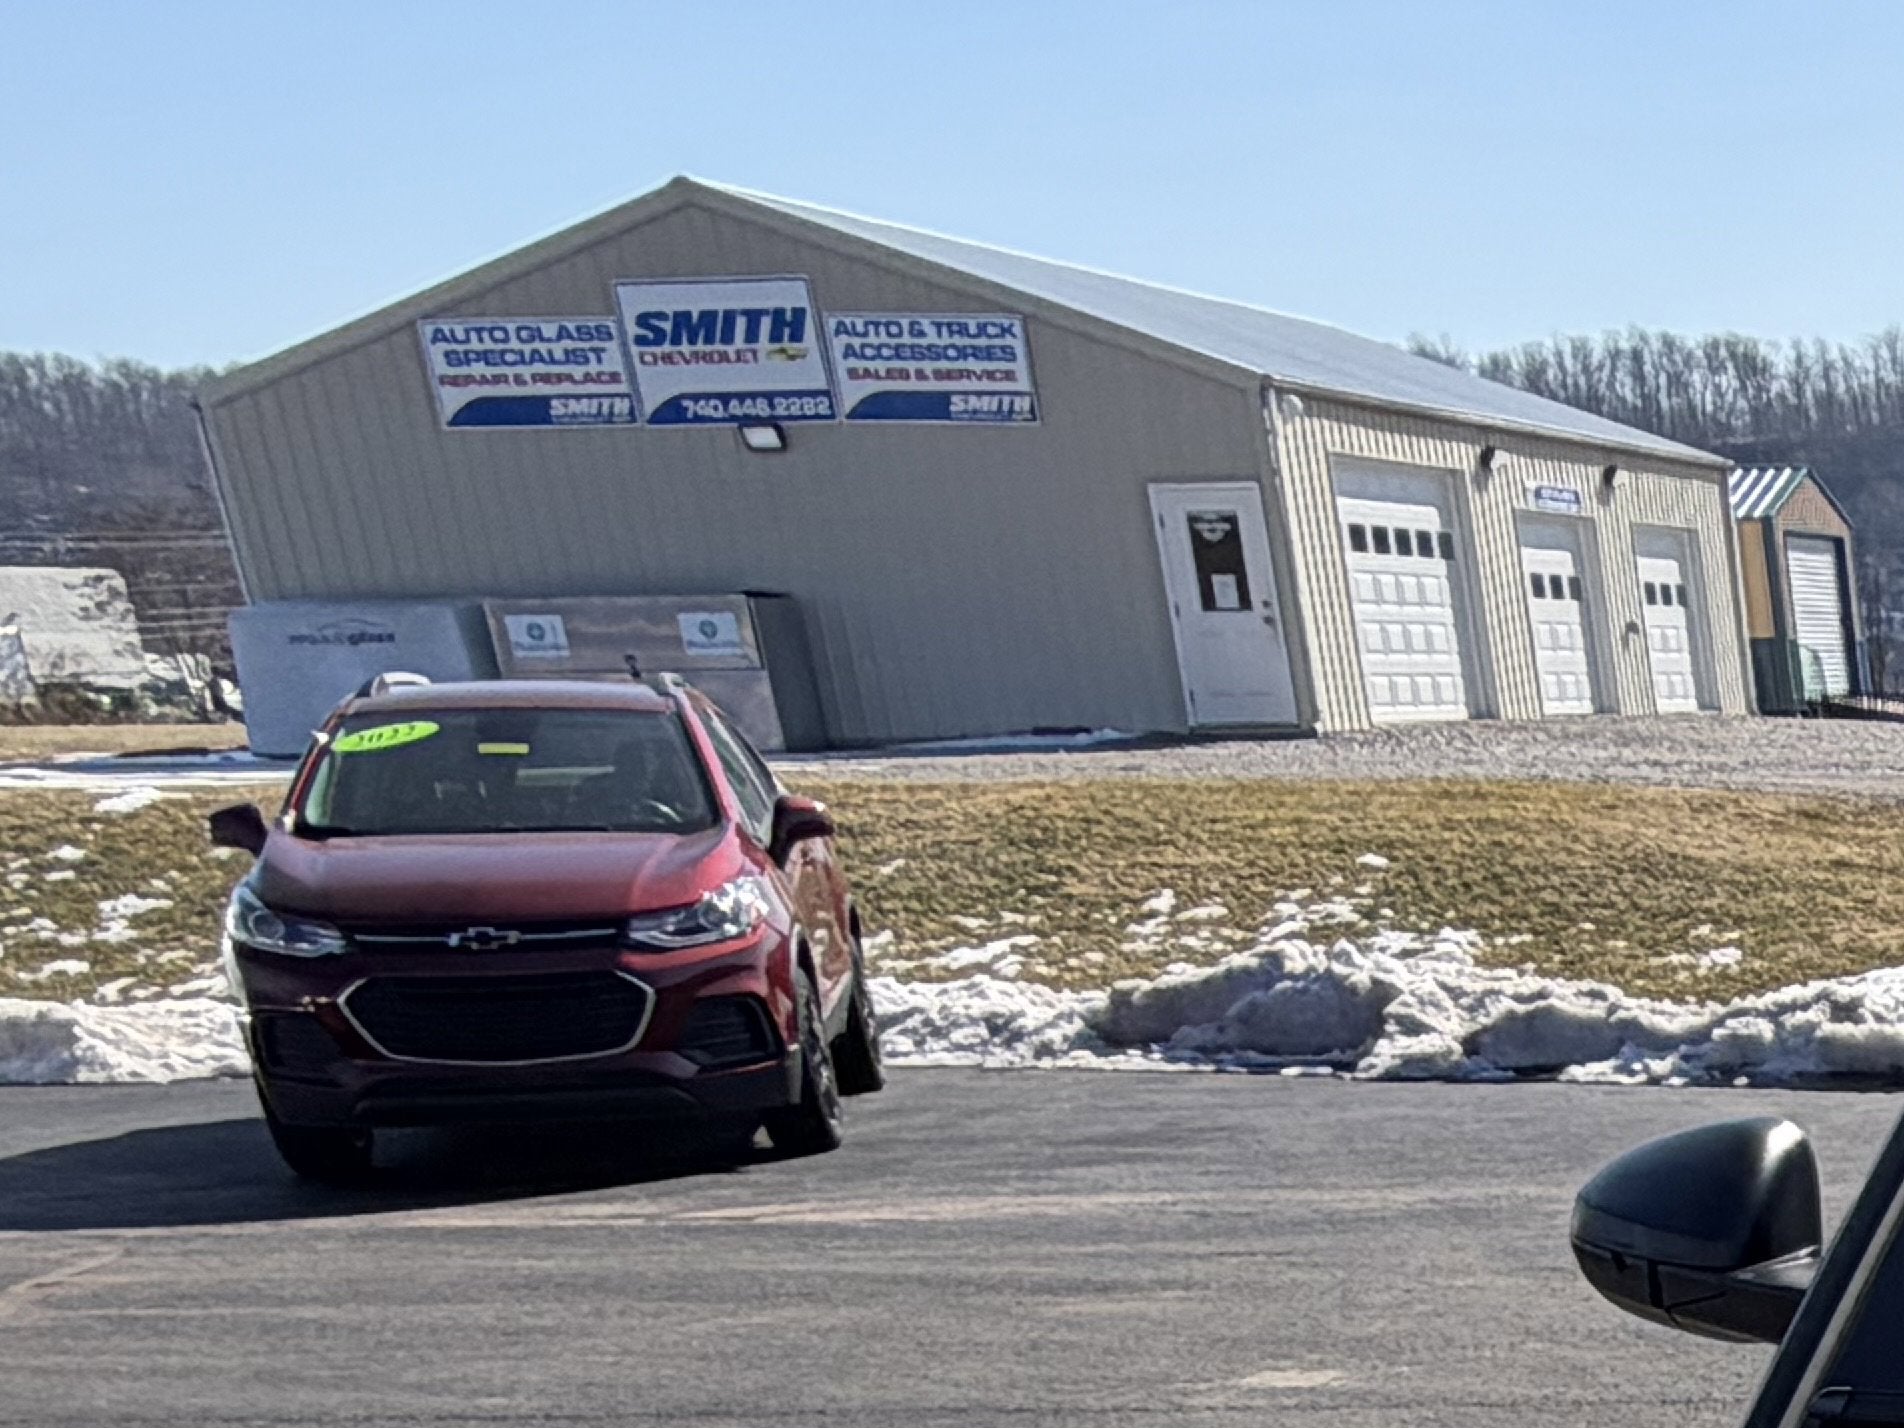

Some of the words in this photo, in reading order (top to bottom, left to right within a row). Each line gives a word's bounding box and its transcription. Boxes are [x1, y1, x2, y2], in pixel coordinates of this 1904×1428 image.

[430, 326, 510, 346] AUTO
[516, 324, 614, 343] GLASS
[633, 306, 807, 346] SMITH
[834, 320, 904, 338] AUTO
[908, 321, 928, 338] &
[931, 320, 1018, 340] TRUCK
[444, 347, 607, 367] SPECIALIST
[638, 348, 758, 366] CHEVROLET
[842, 343, 1017, 362] ACCESSORIES
[438, 373, 511, 388] REPAIR
[932, 368, 1019, 382] SERVICE
[550, 398, 630, 416] SMITH
[950, 394, 1032, 412] SMITH
